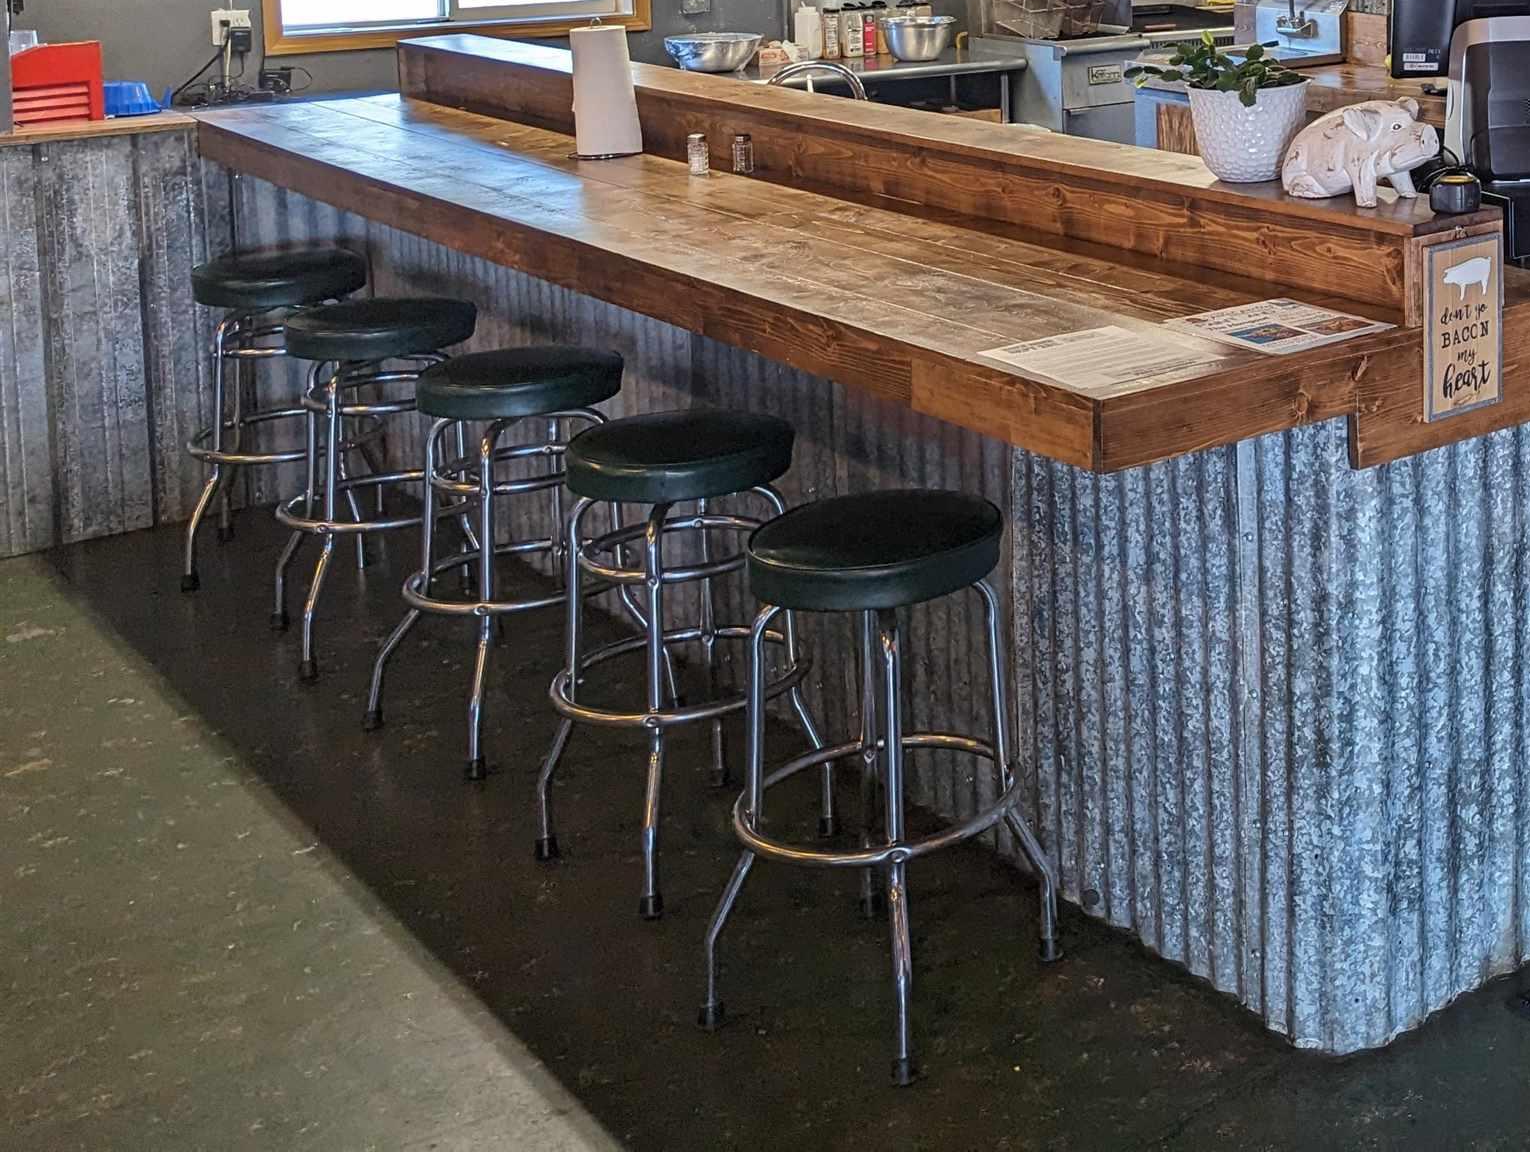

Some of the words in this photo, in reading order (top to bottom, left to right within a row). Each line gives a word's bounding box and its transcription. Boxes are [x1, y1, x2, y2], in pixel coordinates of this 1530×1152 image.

[1441, 320, 1489, 348] BACON
[1457, 348, 1477, 366] my
[1443, 360, 1491, 399] heart
